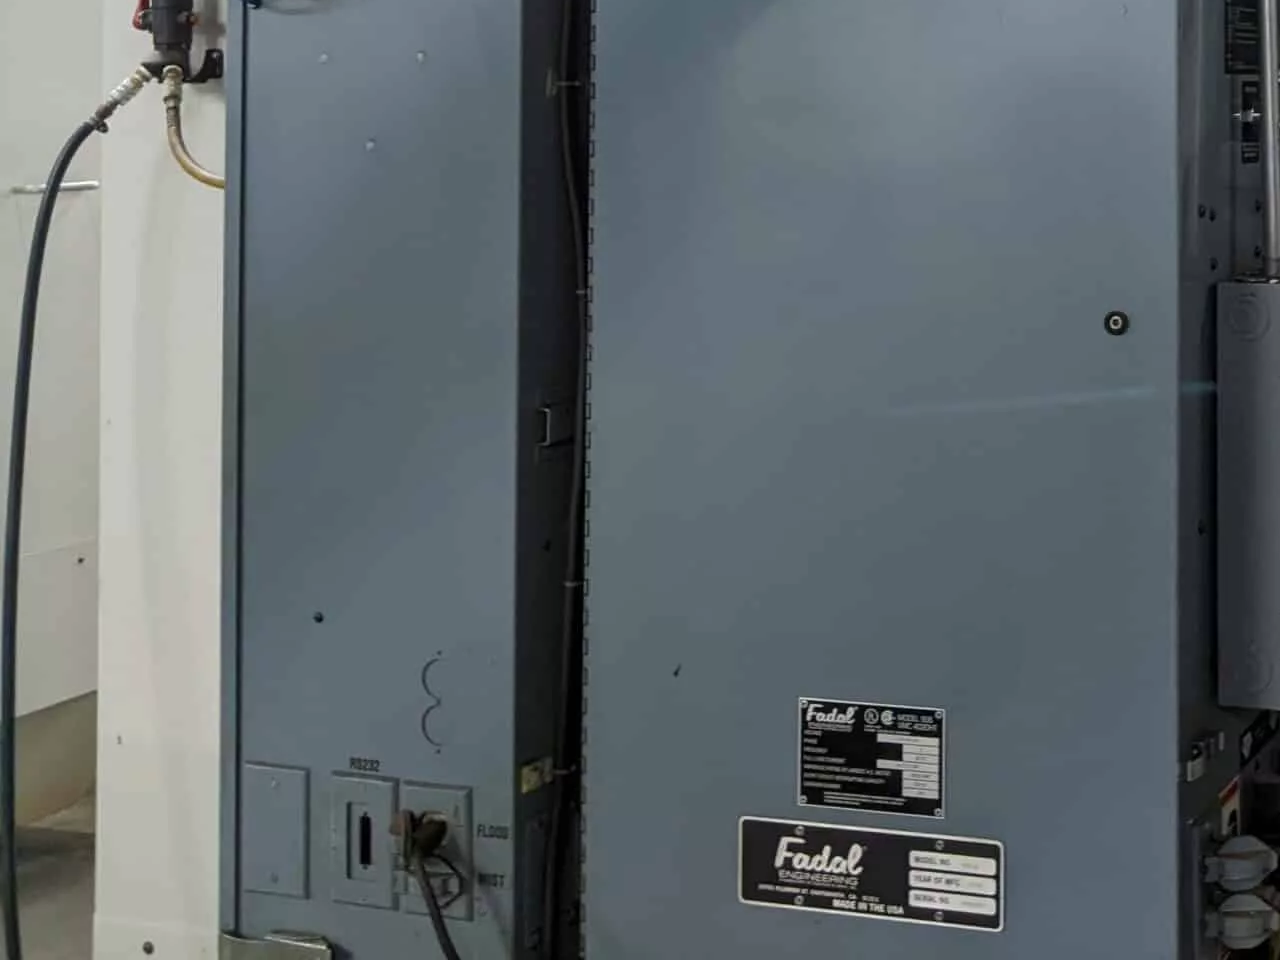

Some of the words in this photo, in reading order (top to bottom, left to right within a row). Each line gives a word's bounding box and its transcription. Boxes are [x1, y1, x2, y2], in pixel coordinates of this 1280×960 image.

[806, 703, 857, 724] Fadal
[774, 836, 863, 875] Fadal
[778, 869, 860, 887] ENGINEERING
[832, 898, 857, 910] MADE
[857, 901, 869, 913] IN
[869, 902, 886, 914] THE
